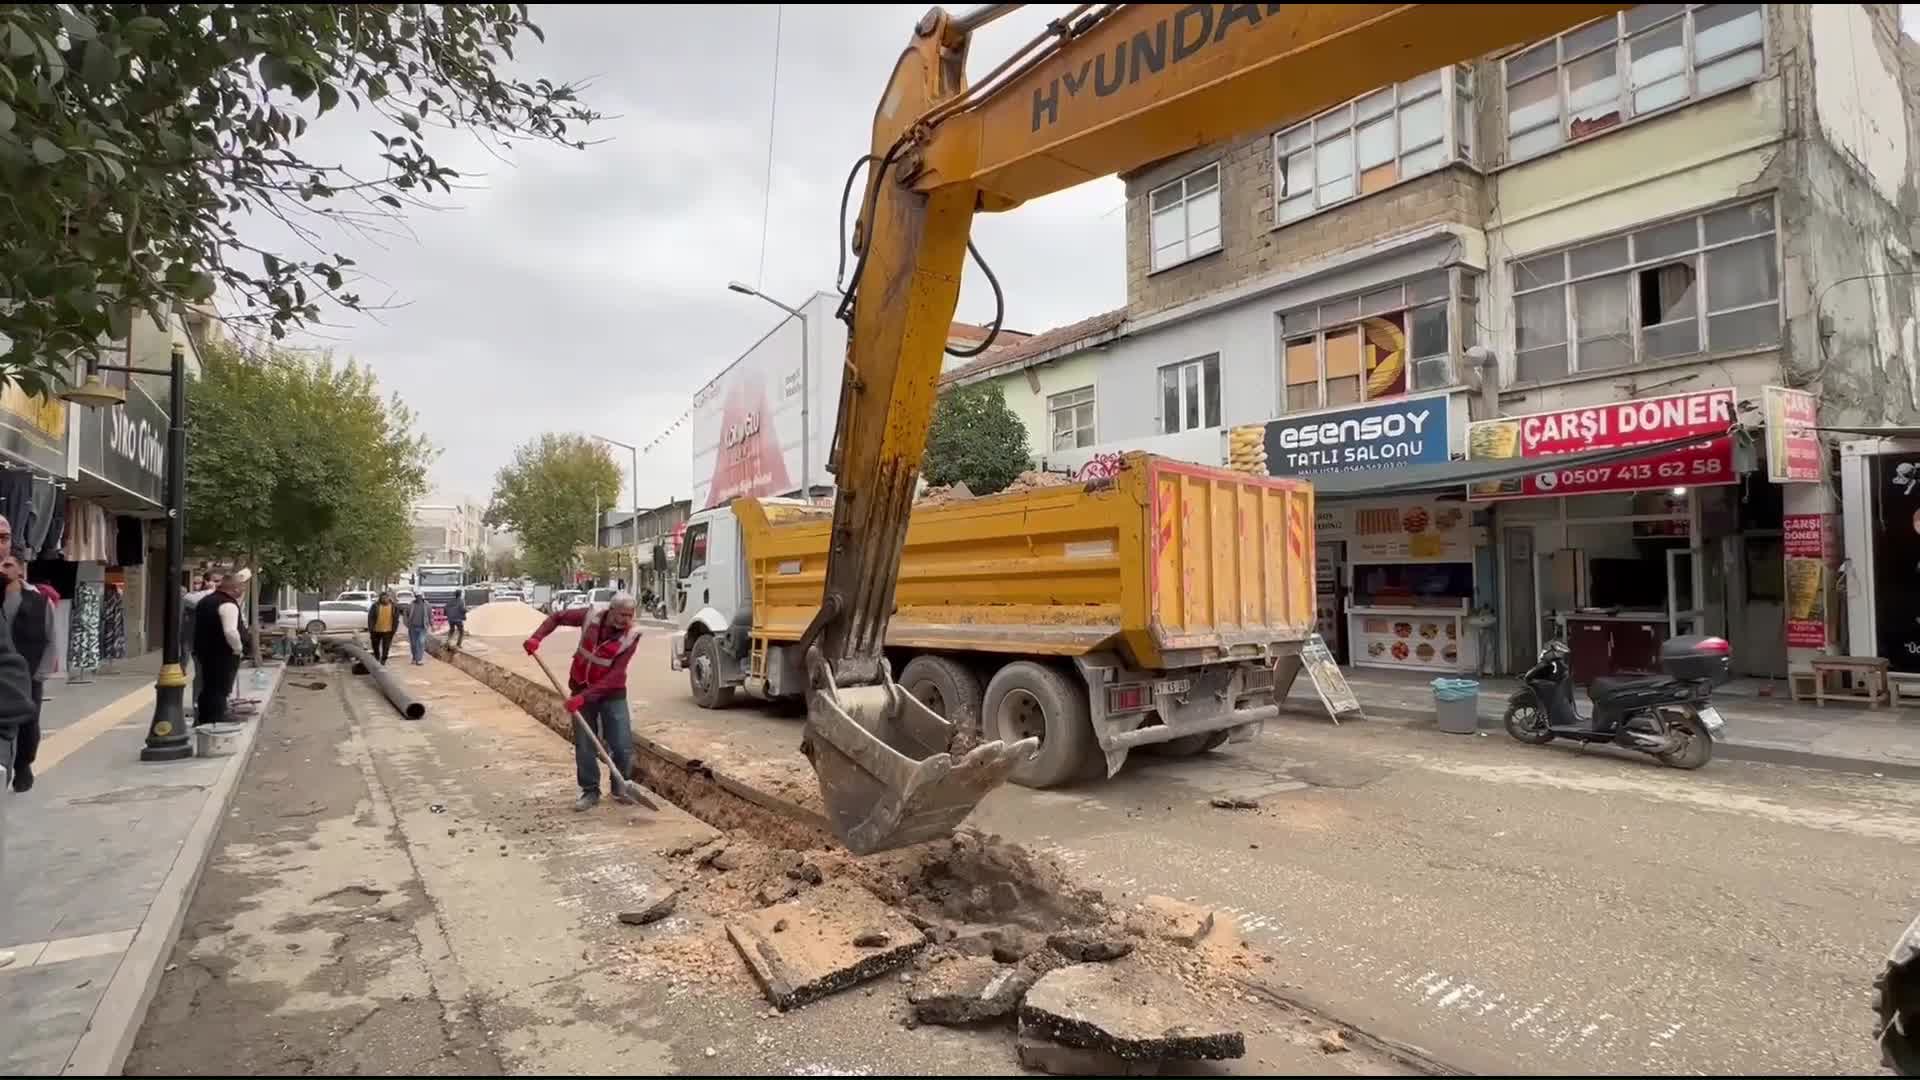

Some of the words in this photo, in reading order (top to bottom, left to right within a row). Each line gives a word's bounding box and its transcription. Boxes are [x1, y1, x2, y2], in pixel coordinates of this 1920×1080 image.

[1031, 4, 1281, 133] HYUNDA
[1524, 410, 1607, 450] ÇARŞI
[1618, 393, 1731, 433] DÖNER
[1287, 449, 1338, 467] TATLI
[1561, 467, 1611, 486] 0507
[1617, 463, 1652, 481] 413
[1658, 460, 1686, 477] 62
[1692, 458, 1722, 474] 58
